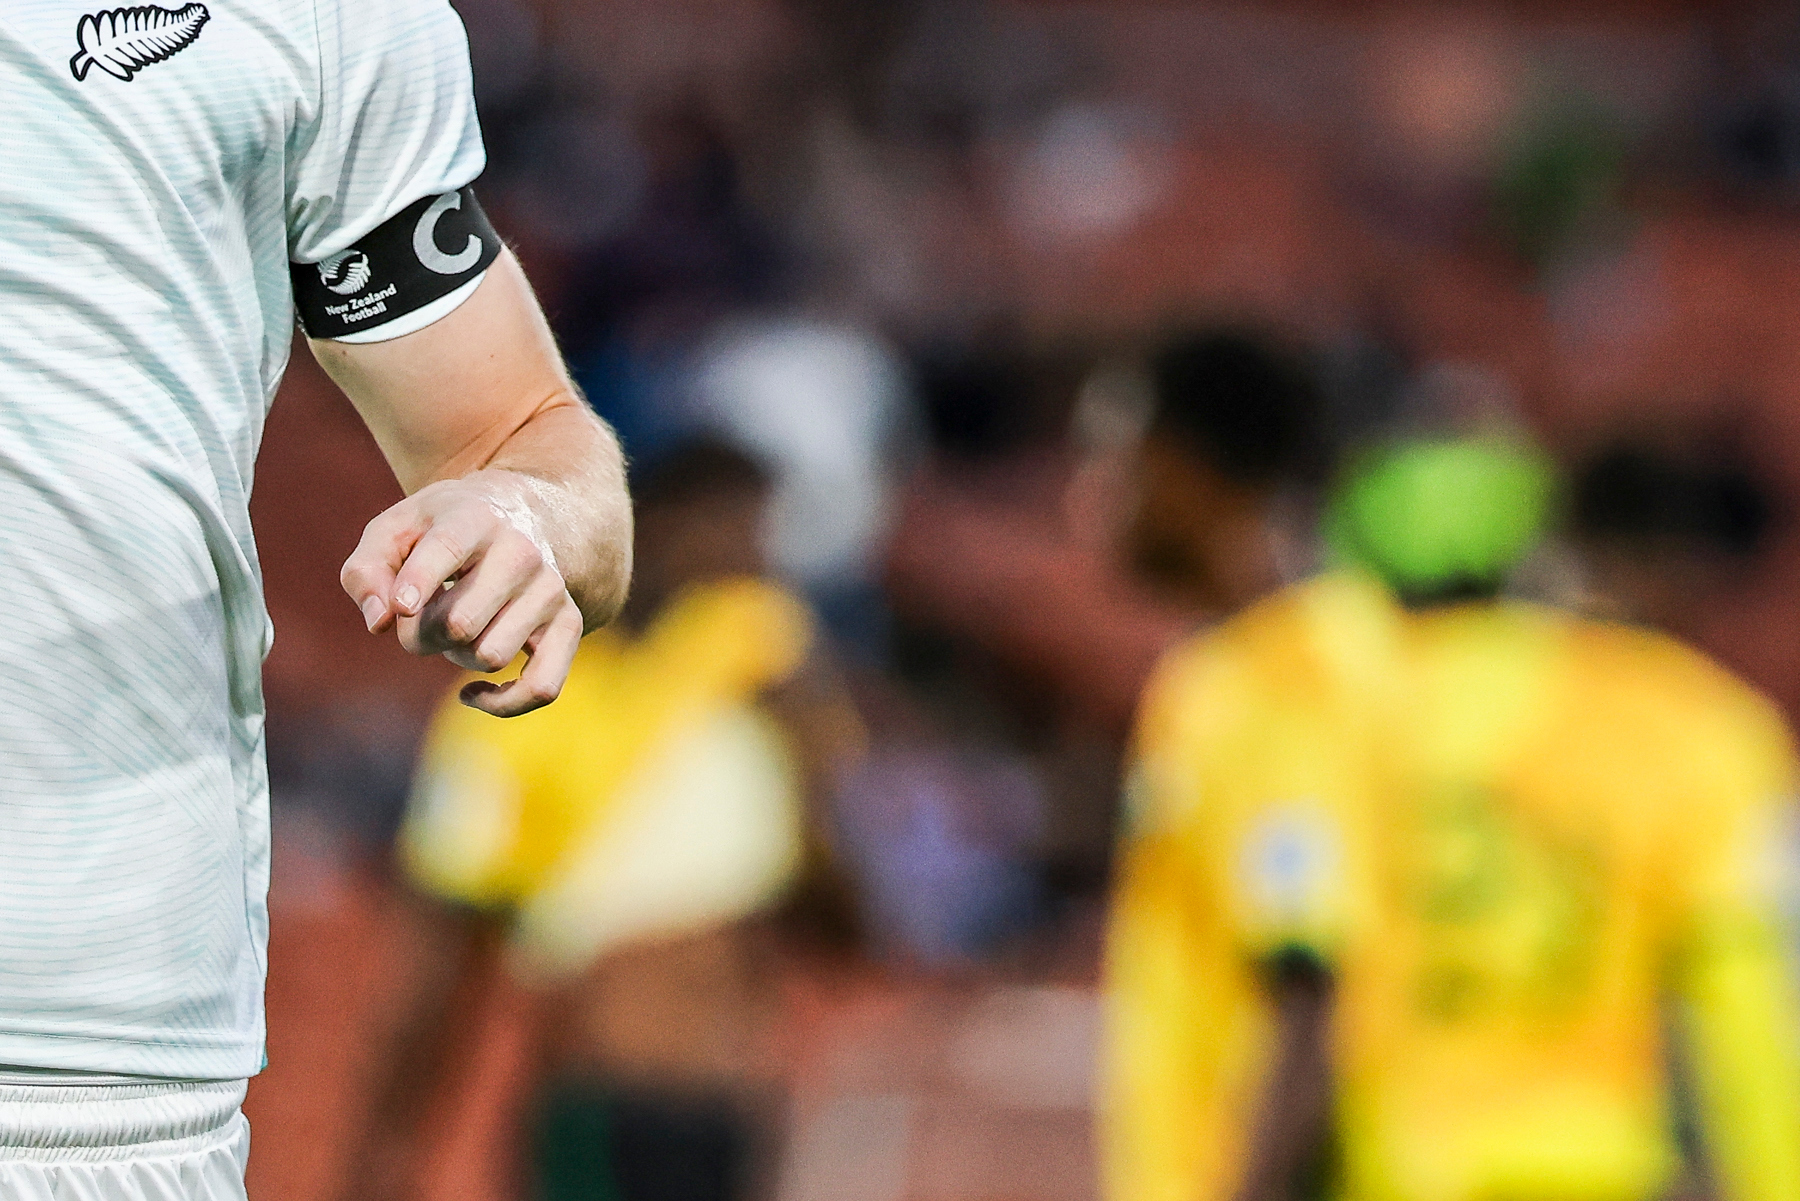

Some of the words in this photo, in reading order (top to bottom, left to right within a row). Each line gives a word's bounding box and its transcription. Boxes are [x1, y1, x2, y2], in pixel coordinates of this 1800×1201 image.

[412, 191, 483, 275] C
[324, 303, 349, 316] New
[349, 282, 398, 310] Zealand
[341, 301, 388, 325] Football
